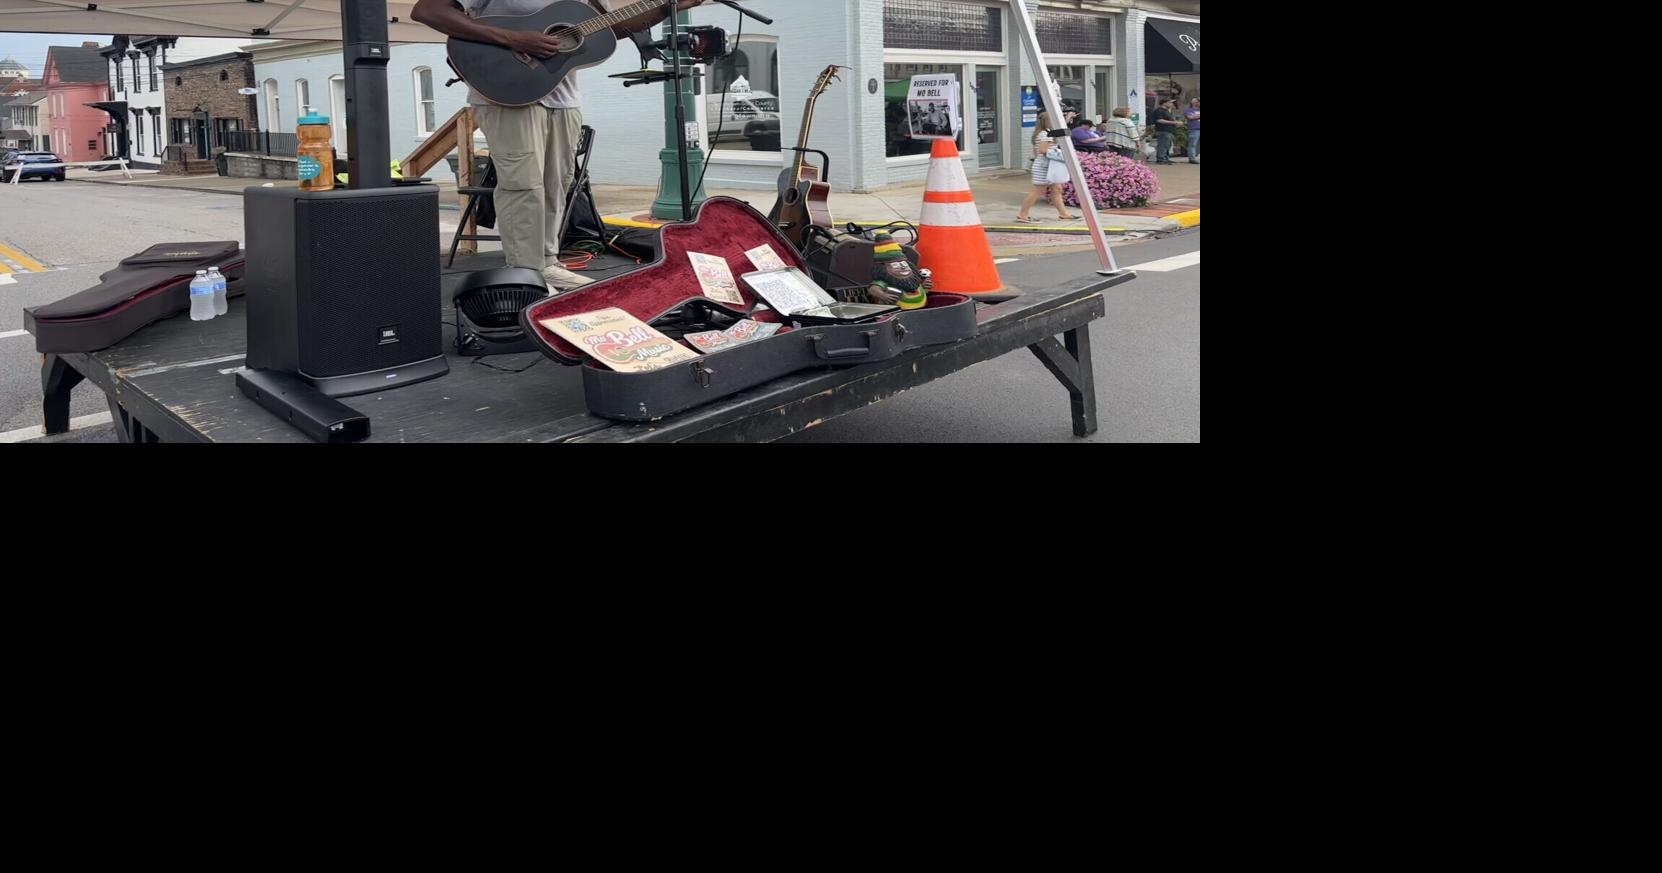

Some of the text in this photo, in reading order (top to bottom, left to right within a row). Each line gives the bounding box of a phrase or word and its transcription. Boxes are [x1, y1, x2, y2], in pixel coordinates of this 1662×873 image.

[916, 88, 941, 97] MO BELL
[606, 326, 653, 347] Bell
[636, 343, 672, 361] Music
